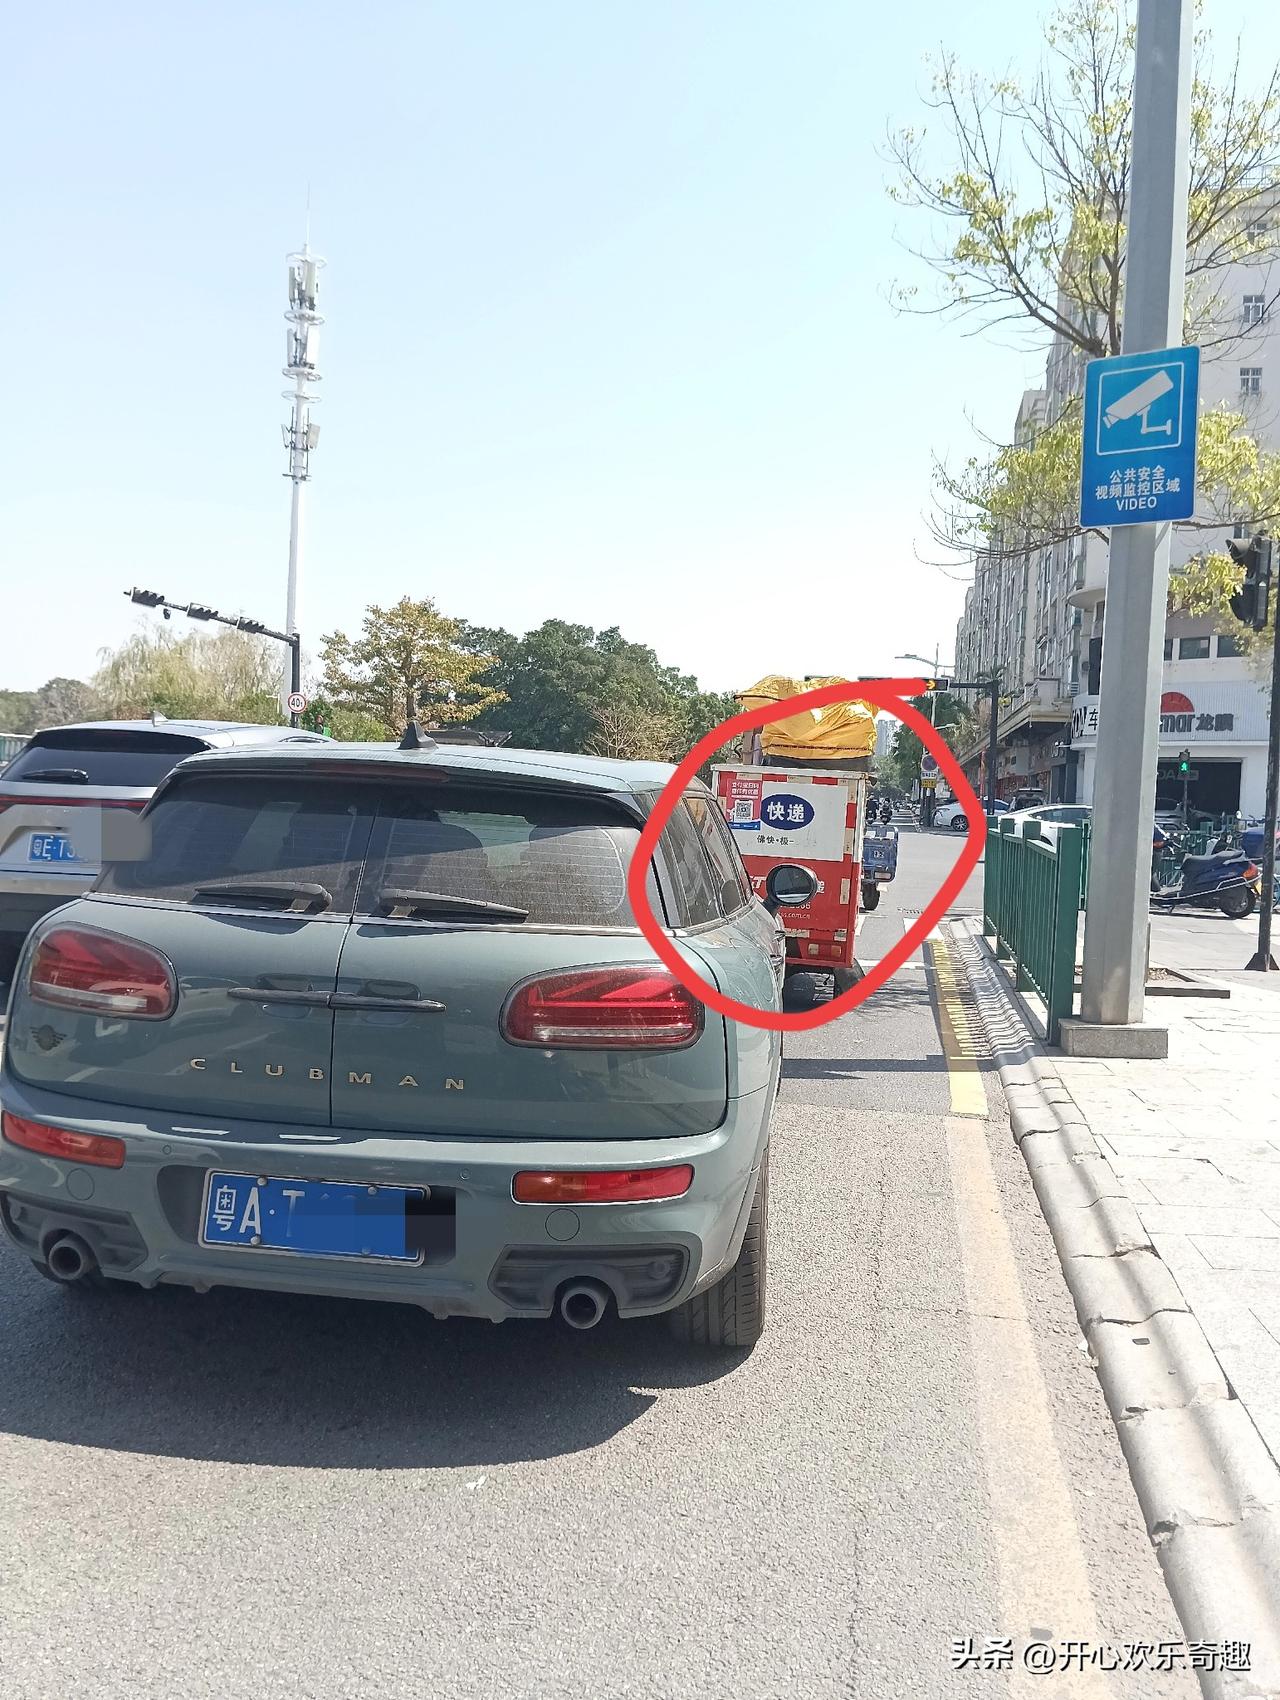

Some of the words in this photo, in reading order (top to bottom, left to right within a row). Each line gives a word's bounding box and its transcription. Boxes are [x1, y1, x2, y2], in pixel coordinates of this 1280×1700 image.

[1110, 464, 1165, 484] 公共安全
[1095, 477, 1181, 500] 视频监控区域
[1116, 496, 1157, 511] VIDEO
[766, 801, 805, 823] 快递
[190, 1058, 464, 1090] CLUBMAN
